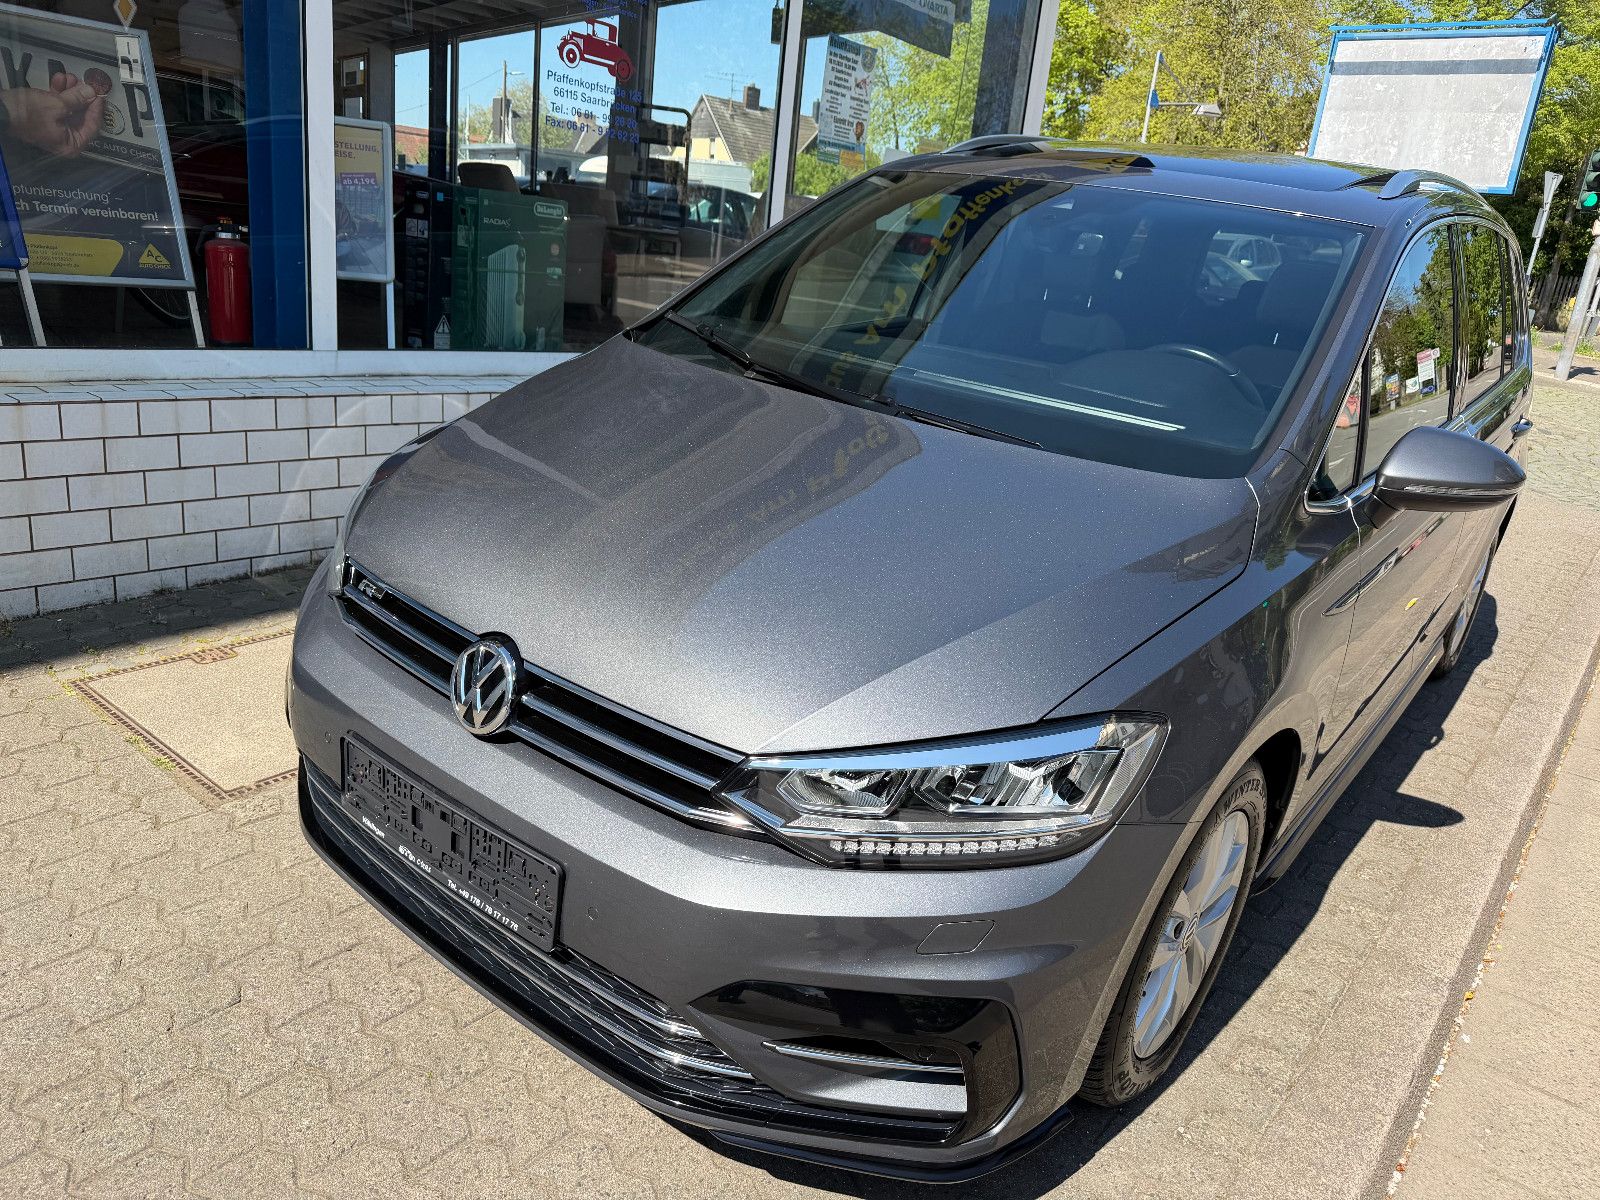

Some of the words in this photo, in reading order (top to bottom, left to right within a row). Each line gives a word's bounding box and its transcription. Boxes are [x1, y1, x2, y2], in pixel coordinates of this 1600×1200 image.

[547, 69, 625, 98] Pfaffenkopfstraße
[553, 86, 579, 101] 66115
[580, 92, 636, 114] Saarbrücken
[550, 101, 569, 116] Tel.:
[571, 106, 582, 118] 06
[584, 109, 594, 120] 81
[545, 115, 564, 127] Fax:
[566, 119, 578, 131] 06
[579, 122, 589, 134] 81
[32, 200, 78, 215] Termin
[81, 206, 159, 222] vereinbaren!
[493, 910, 501, 920] 17
[502, 916, 510, 925] 17
